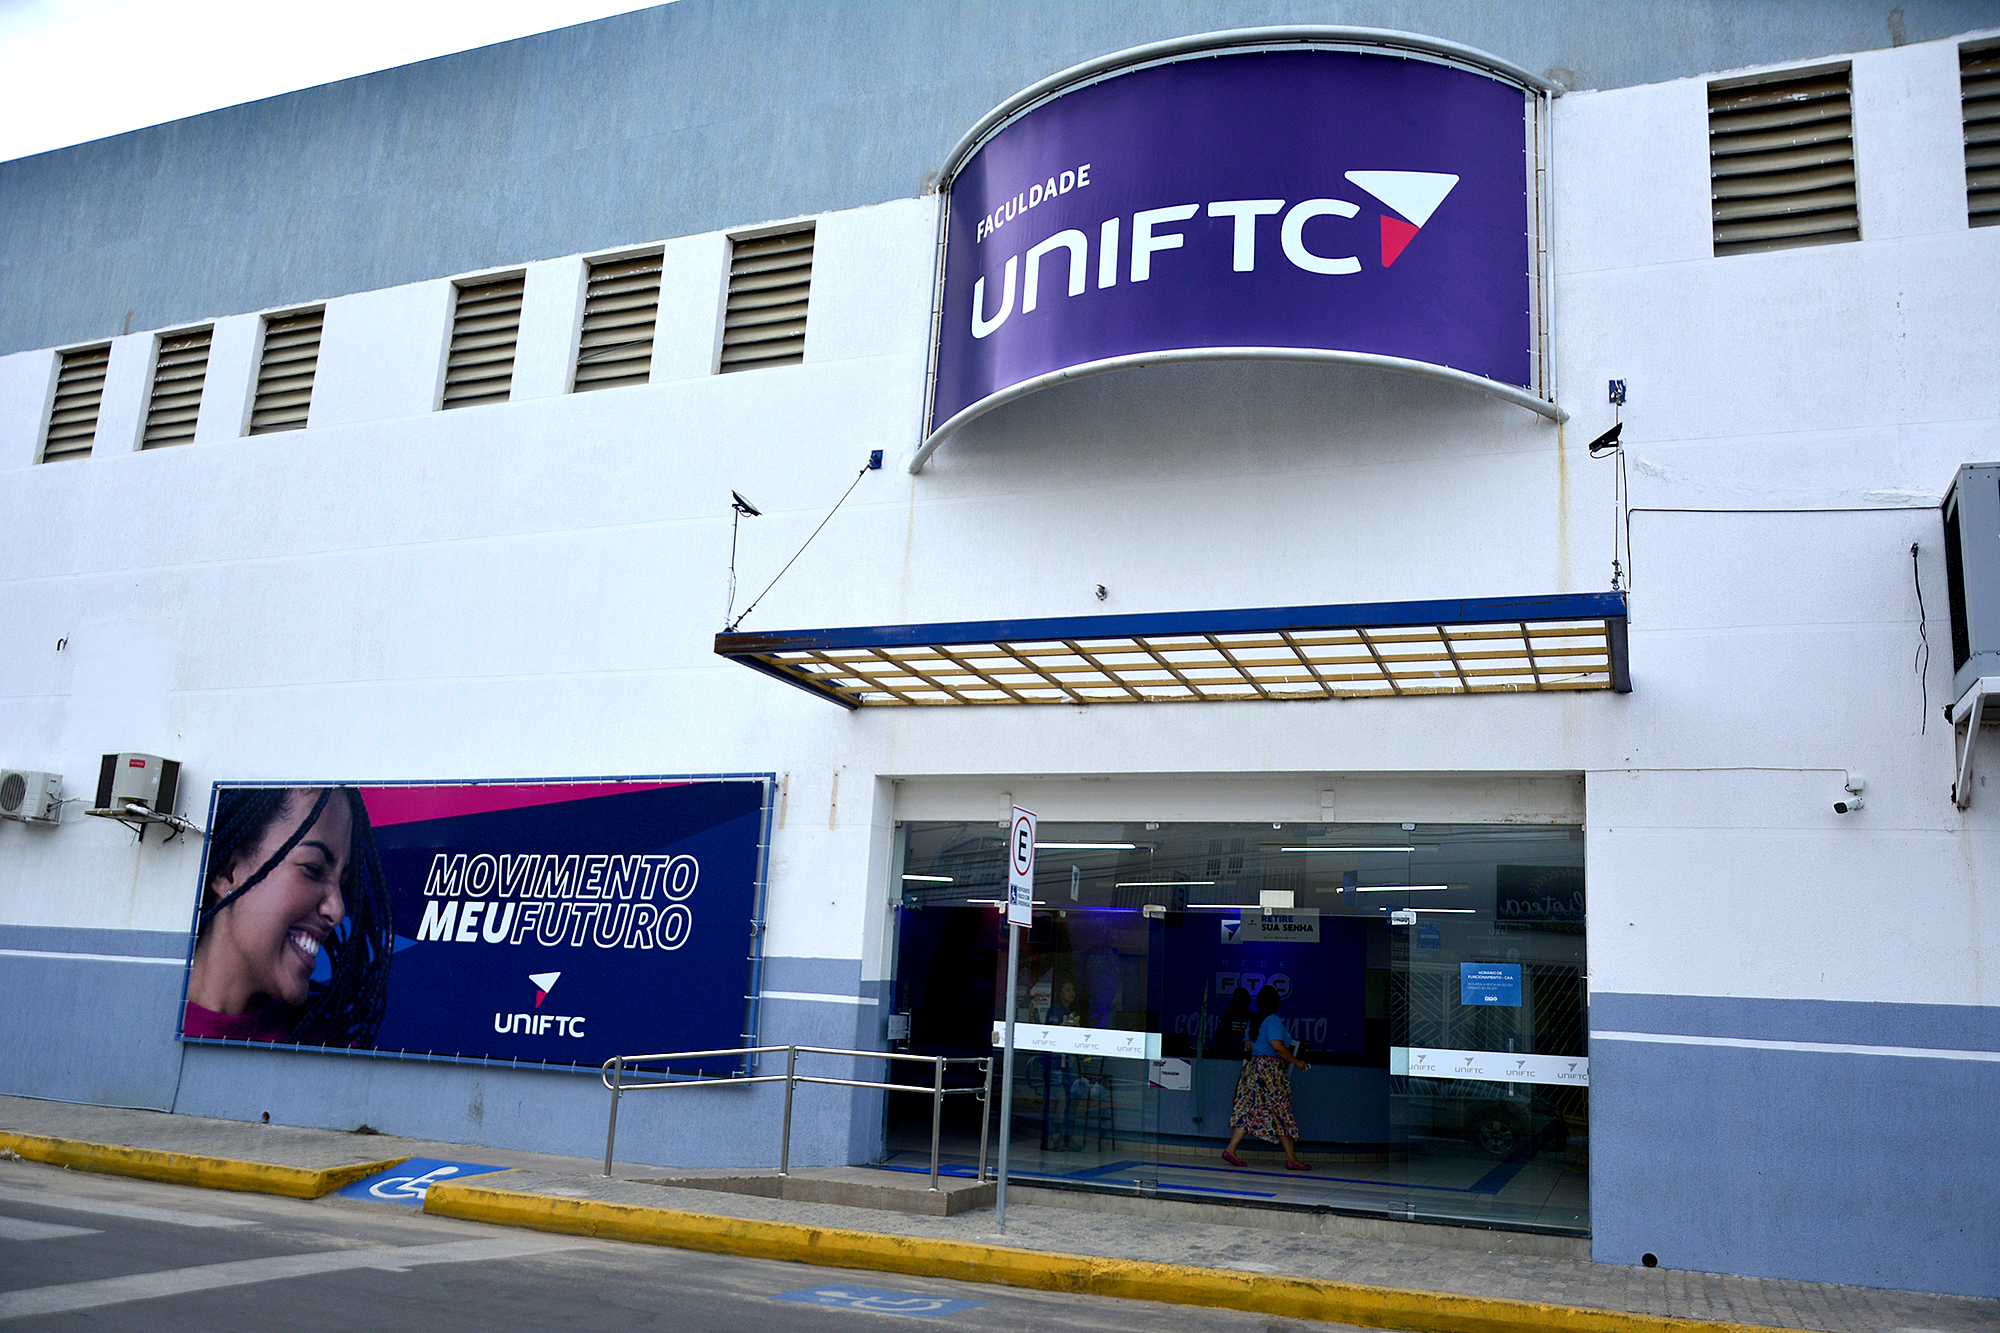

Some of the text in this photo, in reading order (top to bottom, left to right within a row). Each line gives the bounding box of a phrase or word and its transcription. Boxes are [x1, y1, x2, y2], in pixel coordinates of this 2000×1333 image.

[976, 163, 1091, 244] FACULDADE
[971, 198, 1362, 339] UNIFTC
[1018, 829, 1028, 862] E
[424, 853, 699, 901] MOVIMENTO
[1261, 914, 1294, 923] RETIRE
[1261, 923, 1314, 932] SUA SENHA
[494, 1012, 586, 1038] UNIFTC
[1116, 1045, 1142, 1053] UNIFTC
[1454, 1066, 1484, 1074] UNIFTC
[1505, 1069, 1536, 1077] UNIFTC
[1557, 1072, 1587, 1081] UNIFTC
